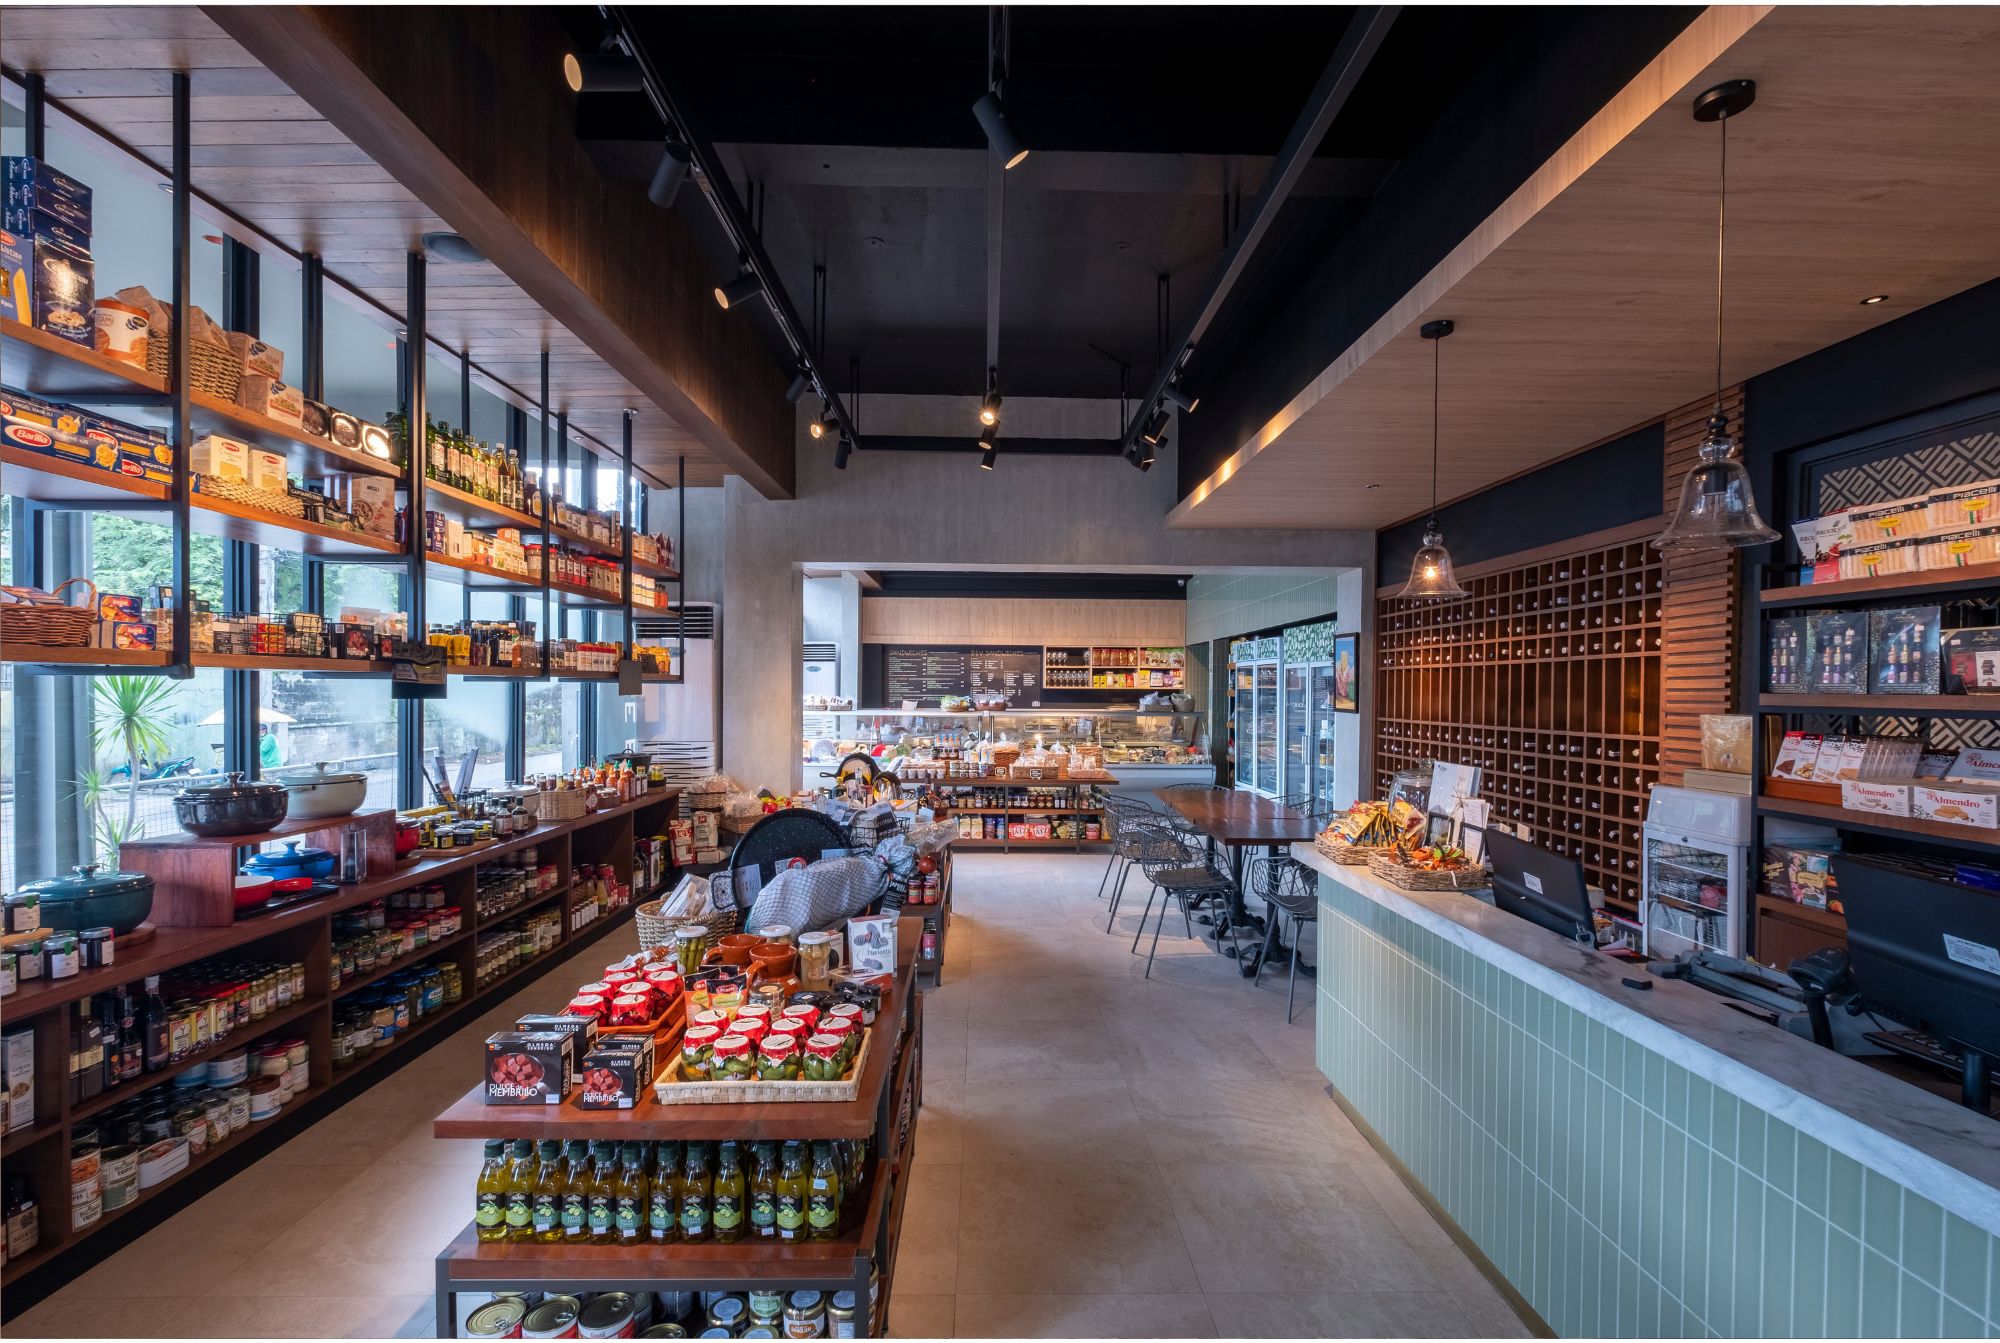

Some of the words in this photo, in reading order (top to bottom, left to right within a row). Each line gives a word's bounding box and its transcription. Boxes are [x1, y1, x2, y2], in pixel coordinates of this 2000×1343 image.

[16, 429, 49, 444] Barilla
[122, 463, 142, 474] arilla
[1934, 796, 1981, 809] Almendro
